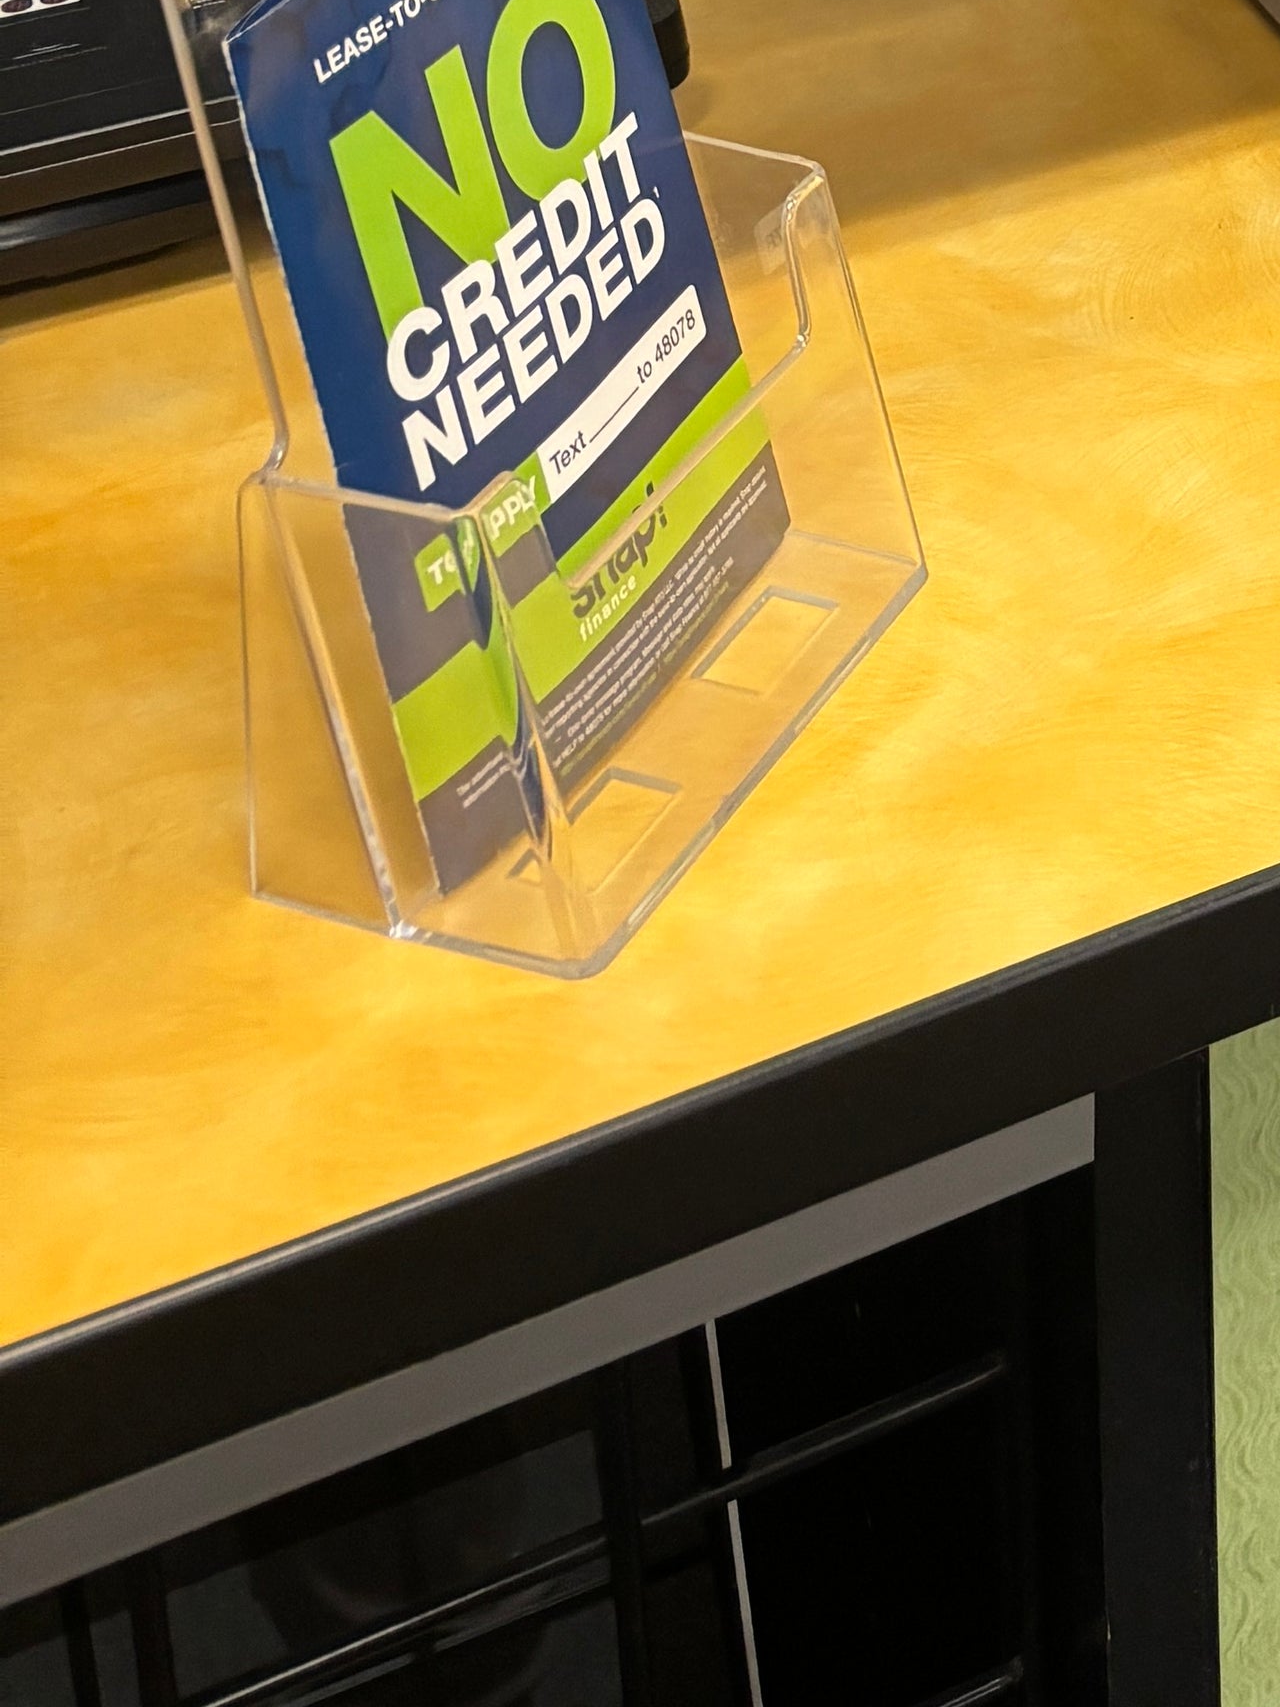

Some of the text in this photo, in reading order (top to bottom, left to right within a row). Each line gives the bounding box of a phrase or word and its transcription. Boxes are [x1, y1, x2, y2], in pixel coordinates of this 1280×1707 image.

[387, 111, 639, 402] CREDIT
[549, 308, 696, 475] Text to 48078
[579, 575, 638, 643] finance
